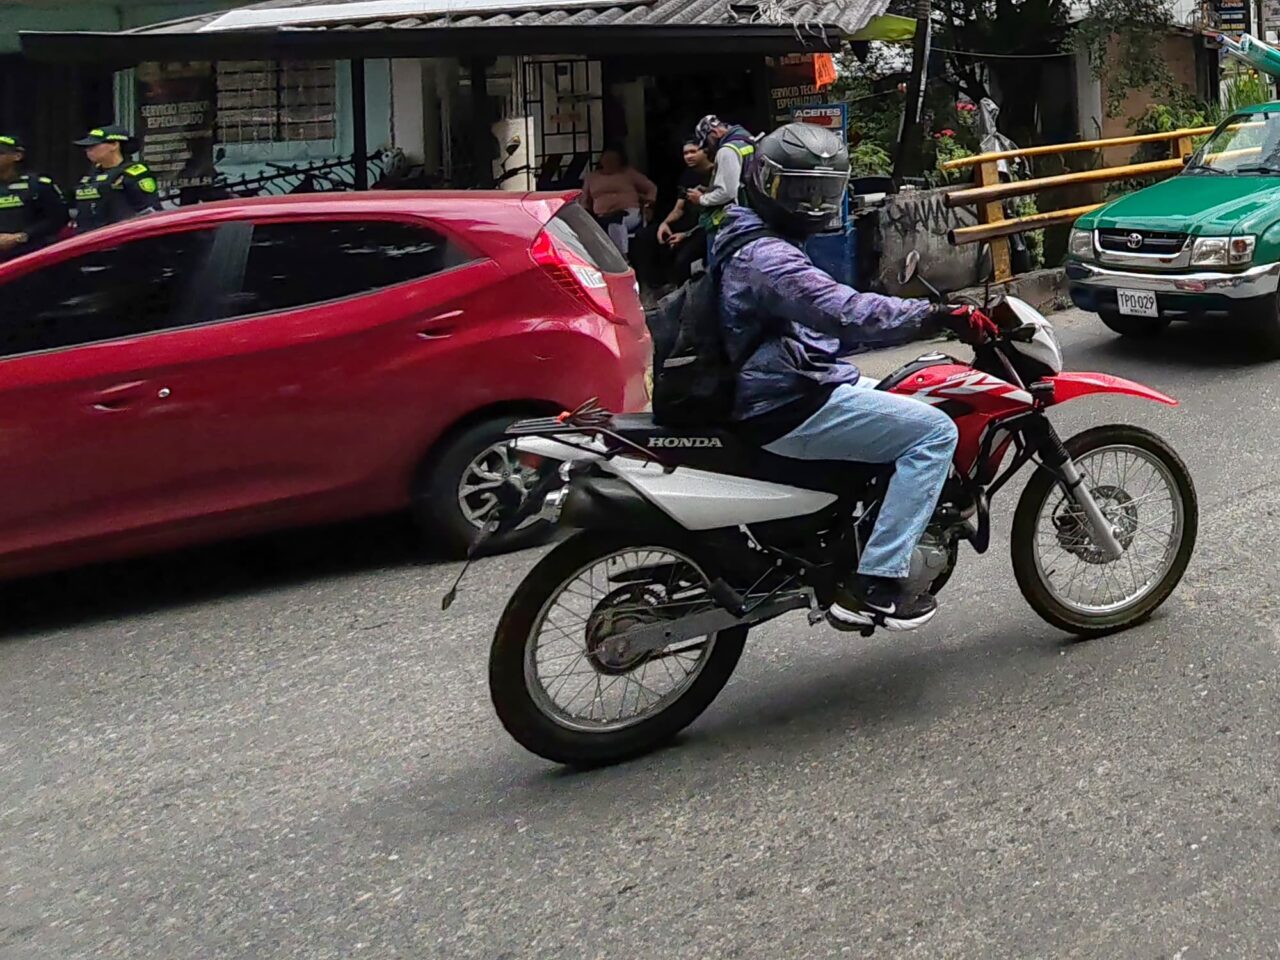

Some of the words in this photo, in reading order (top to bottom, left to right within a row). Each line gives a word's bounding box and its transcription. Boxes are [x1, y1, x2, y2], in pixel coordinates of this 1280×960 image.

[771, 87, 799, 98] SERVICIO
[795, 108, 841, 117] ACEITES
[647, 437, 723, 447] HONDA
